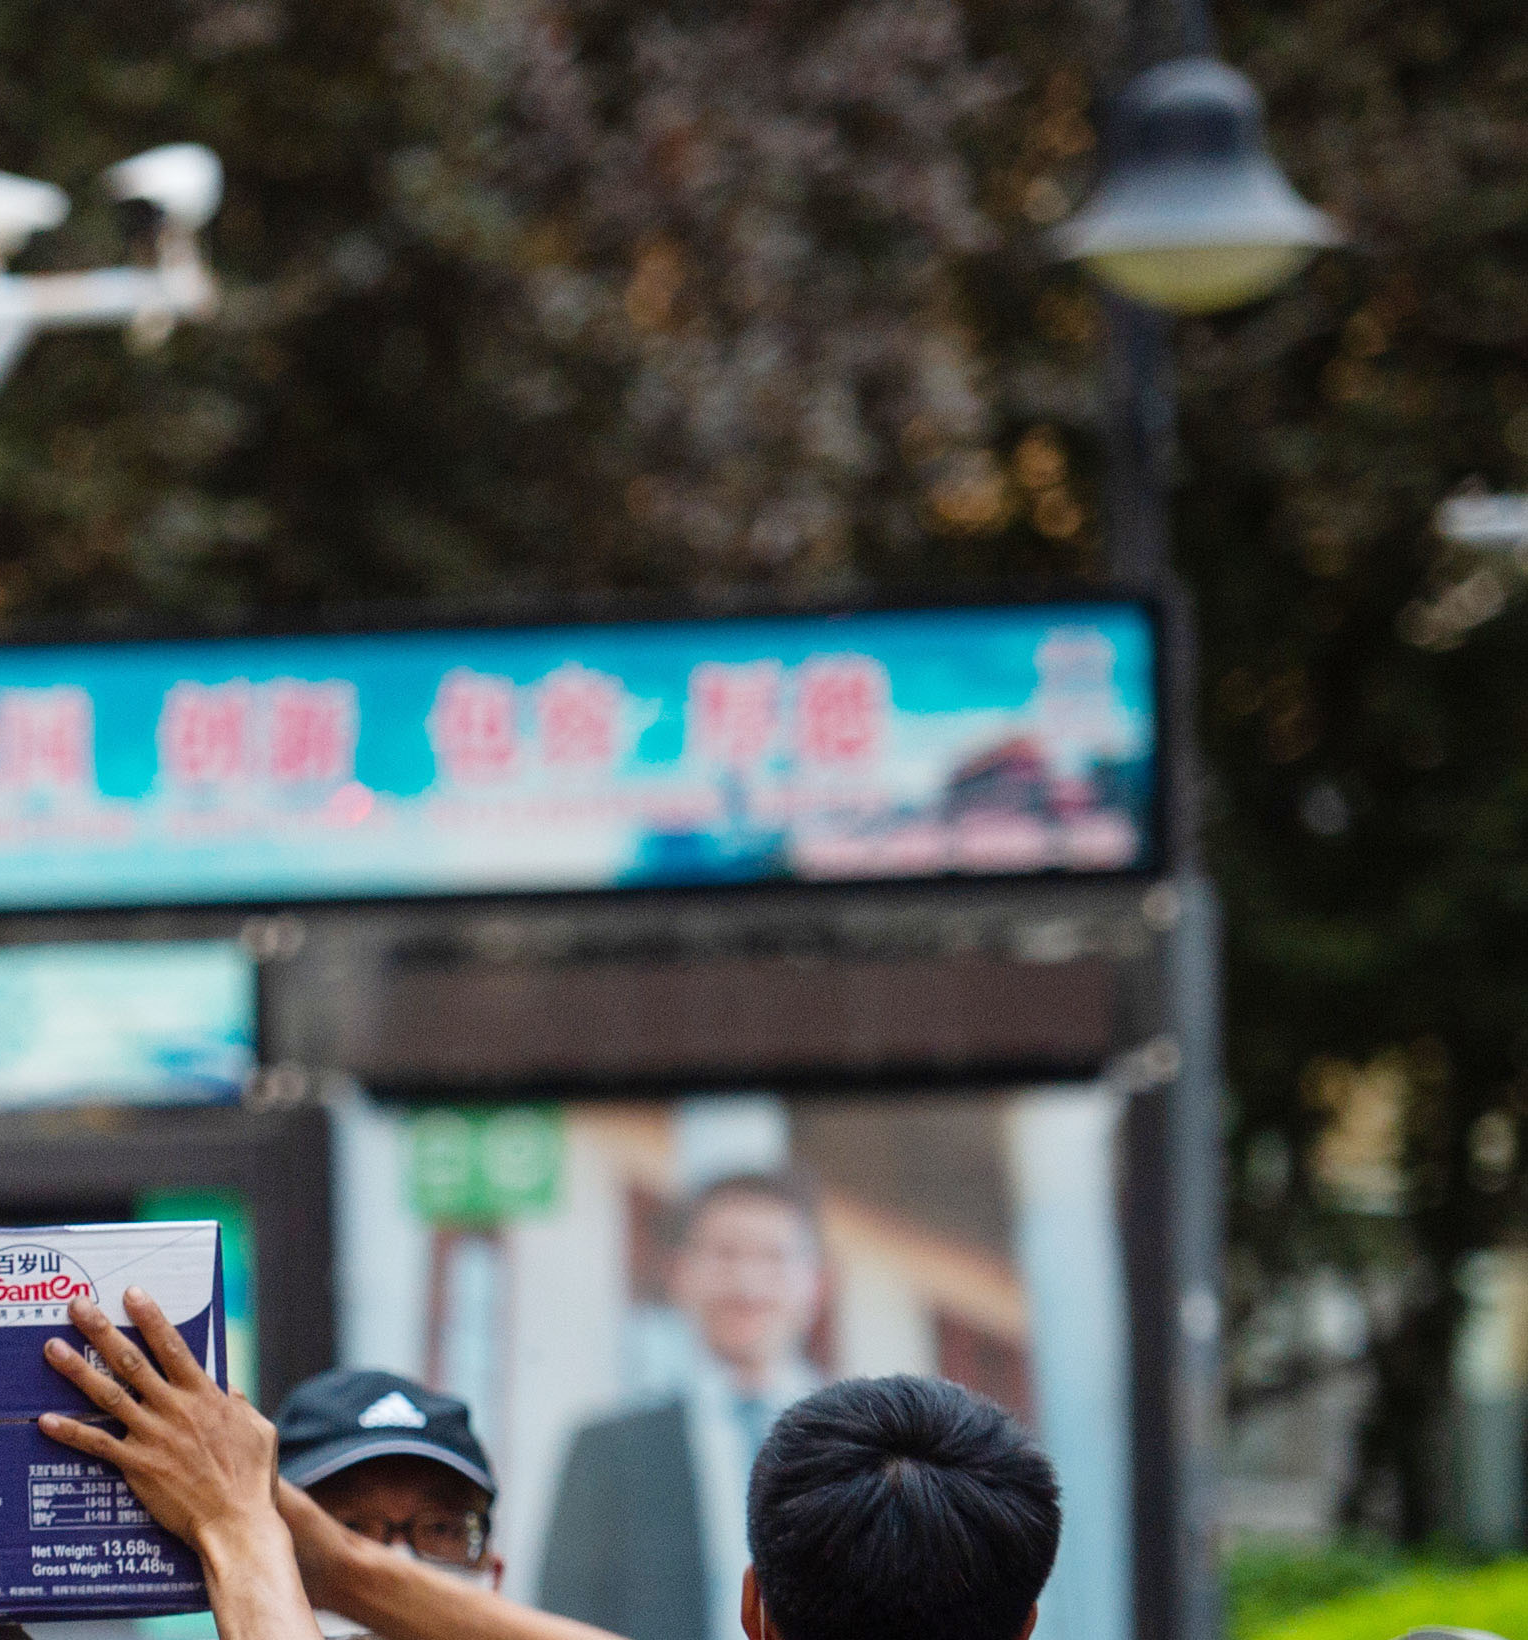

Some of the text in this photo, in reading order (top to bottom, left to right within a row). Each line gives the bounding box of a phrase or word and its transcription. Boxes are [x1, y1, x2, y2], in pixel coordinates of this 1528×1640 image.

[31, 1540, 161, 1560] Net Weight: 13.68kg
[32, 1558, 175, 1578] Gross Weight: 14.48kg
